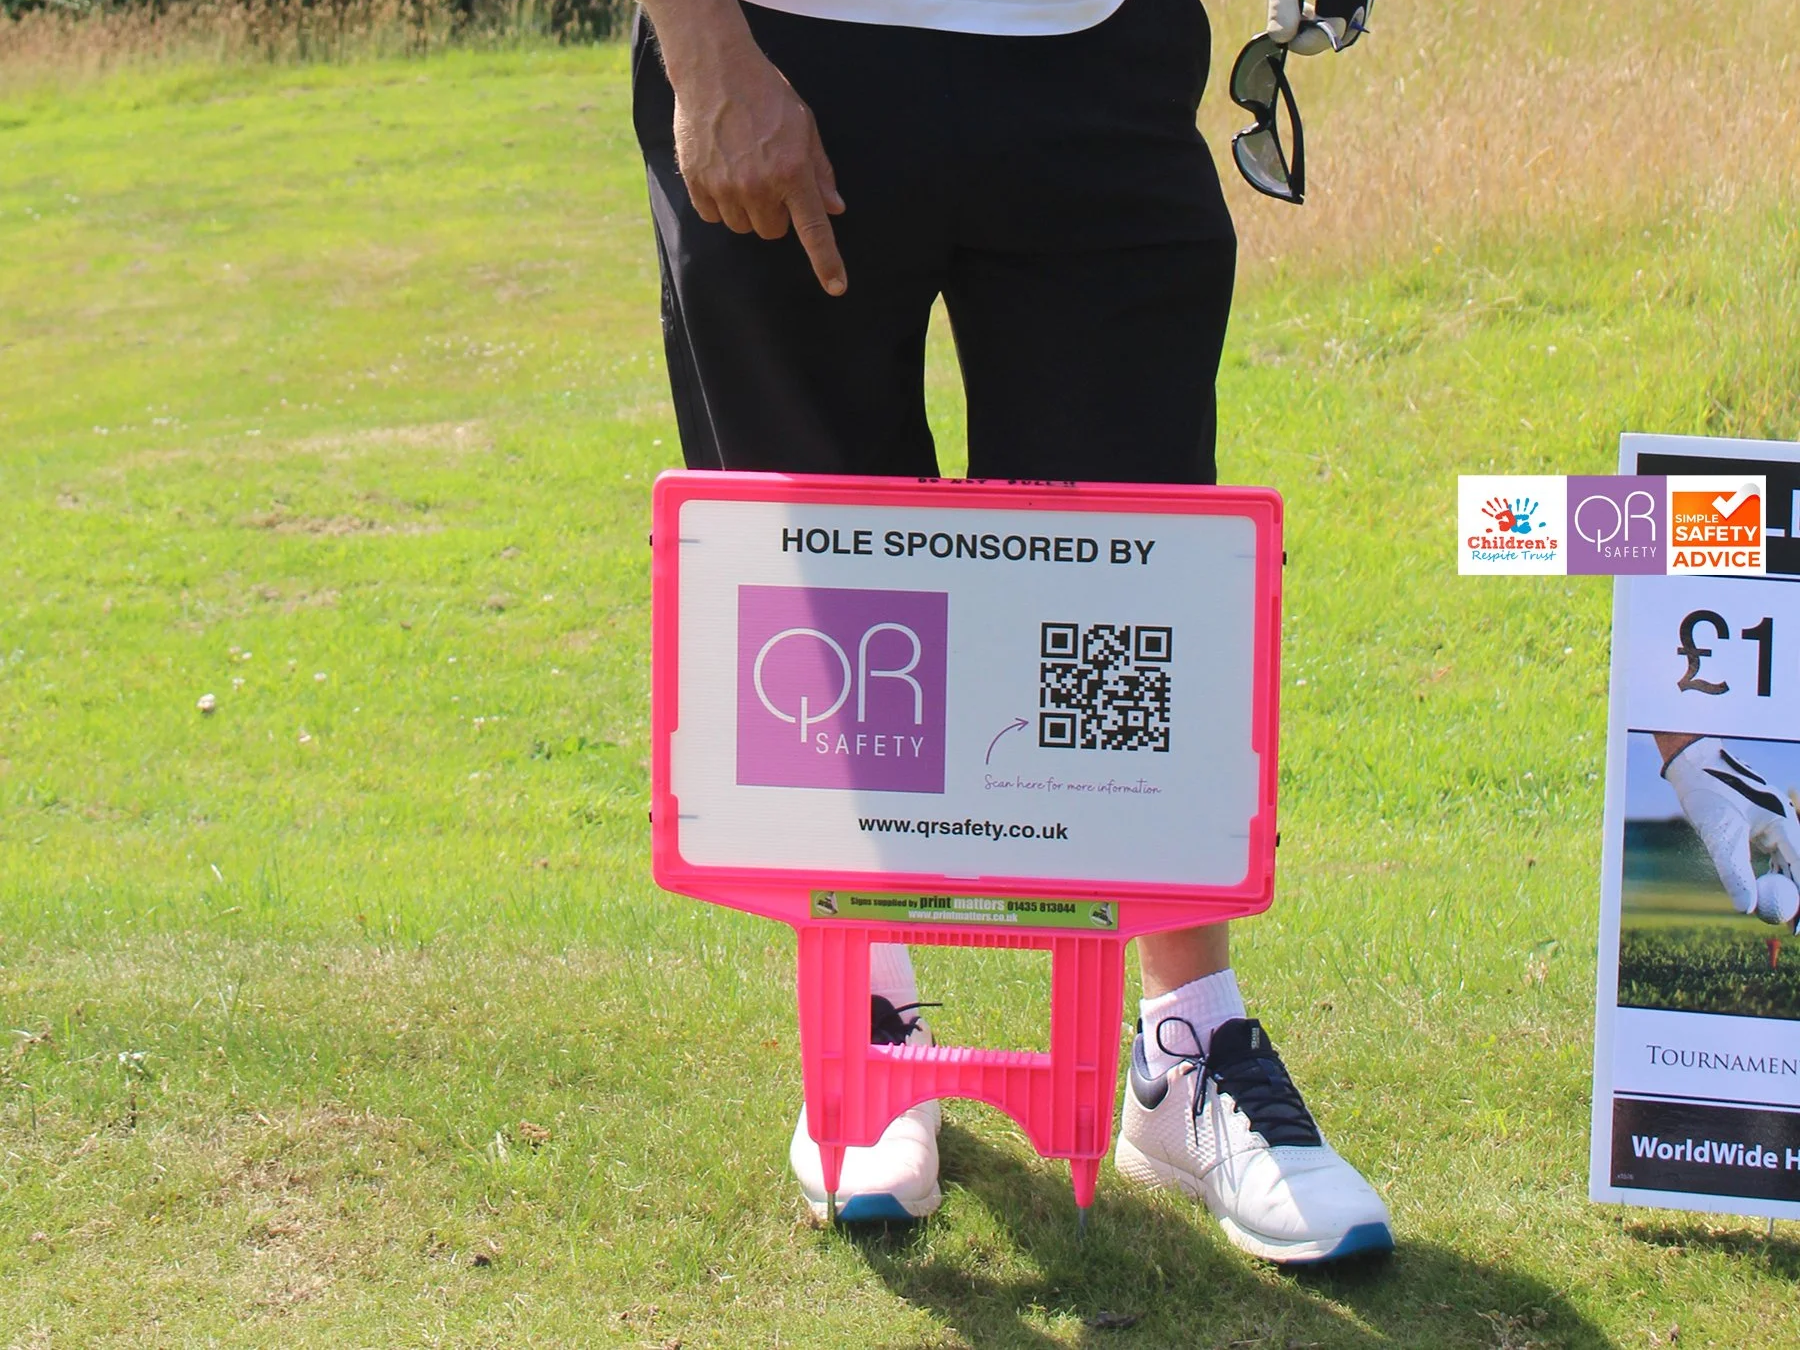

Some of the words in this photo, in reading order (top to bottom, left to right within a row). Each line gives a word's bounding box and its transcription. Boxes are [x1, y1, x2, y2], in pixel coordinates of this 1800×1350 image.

[782, 528, 873, 555] HOLE
[884, 530, 1099, 563] SPONSORED
[1110, 539, 1155, 565] BY
[753, 622, 923, 743] QR
[815, 732, 924, 758] SAFETY
[984, 773, 1015, 790] Scan
[1016, 776, 1045, 790] here
[1046, 776, 1062, 793] for
[1066, 783, 1095, 792] more
[1097, 778, 1162, 795] information
[858, 816, 1069, 842] www.qrsafety.co.uk
[850, 896, 872, 906] Signs
[919, 895, 952, 909] print
[953, 897, 1005, 911] matters
[908, 910, 1018, 923] www.printmatters.co.uk
[1646, 1044, 1800, 1075] TOURNAMEN
[1632, 1134, 1778, 1169] WorldWide
